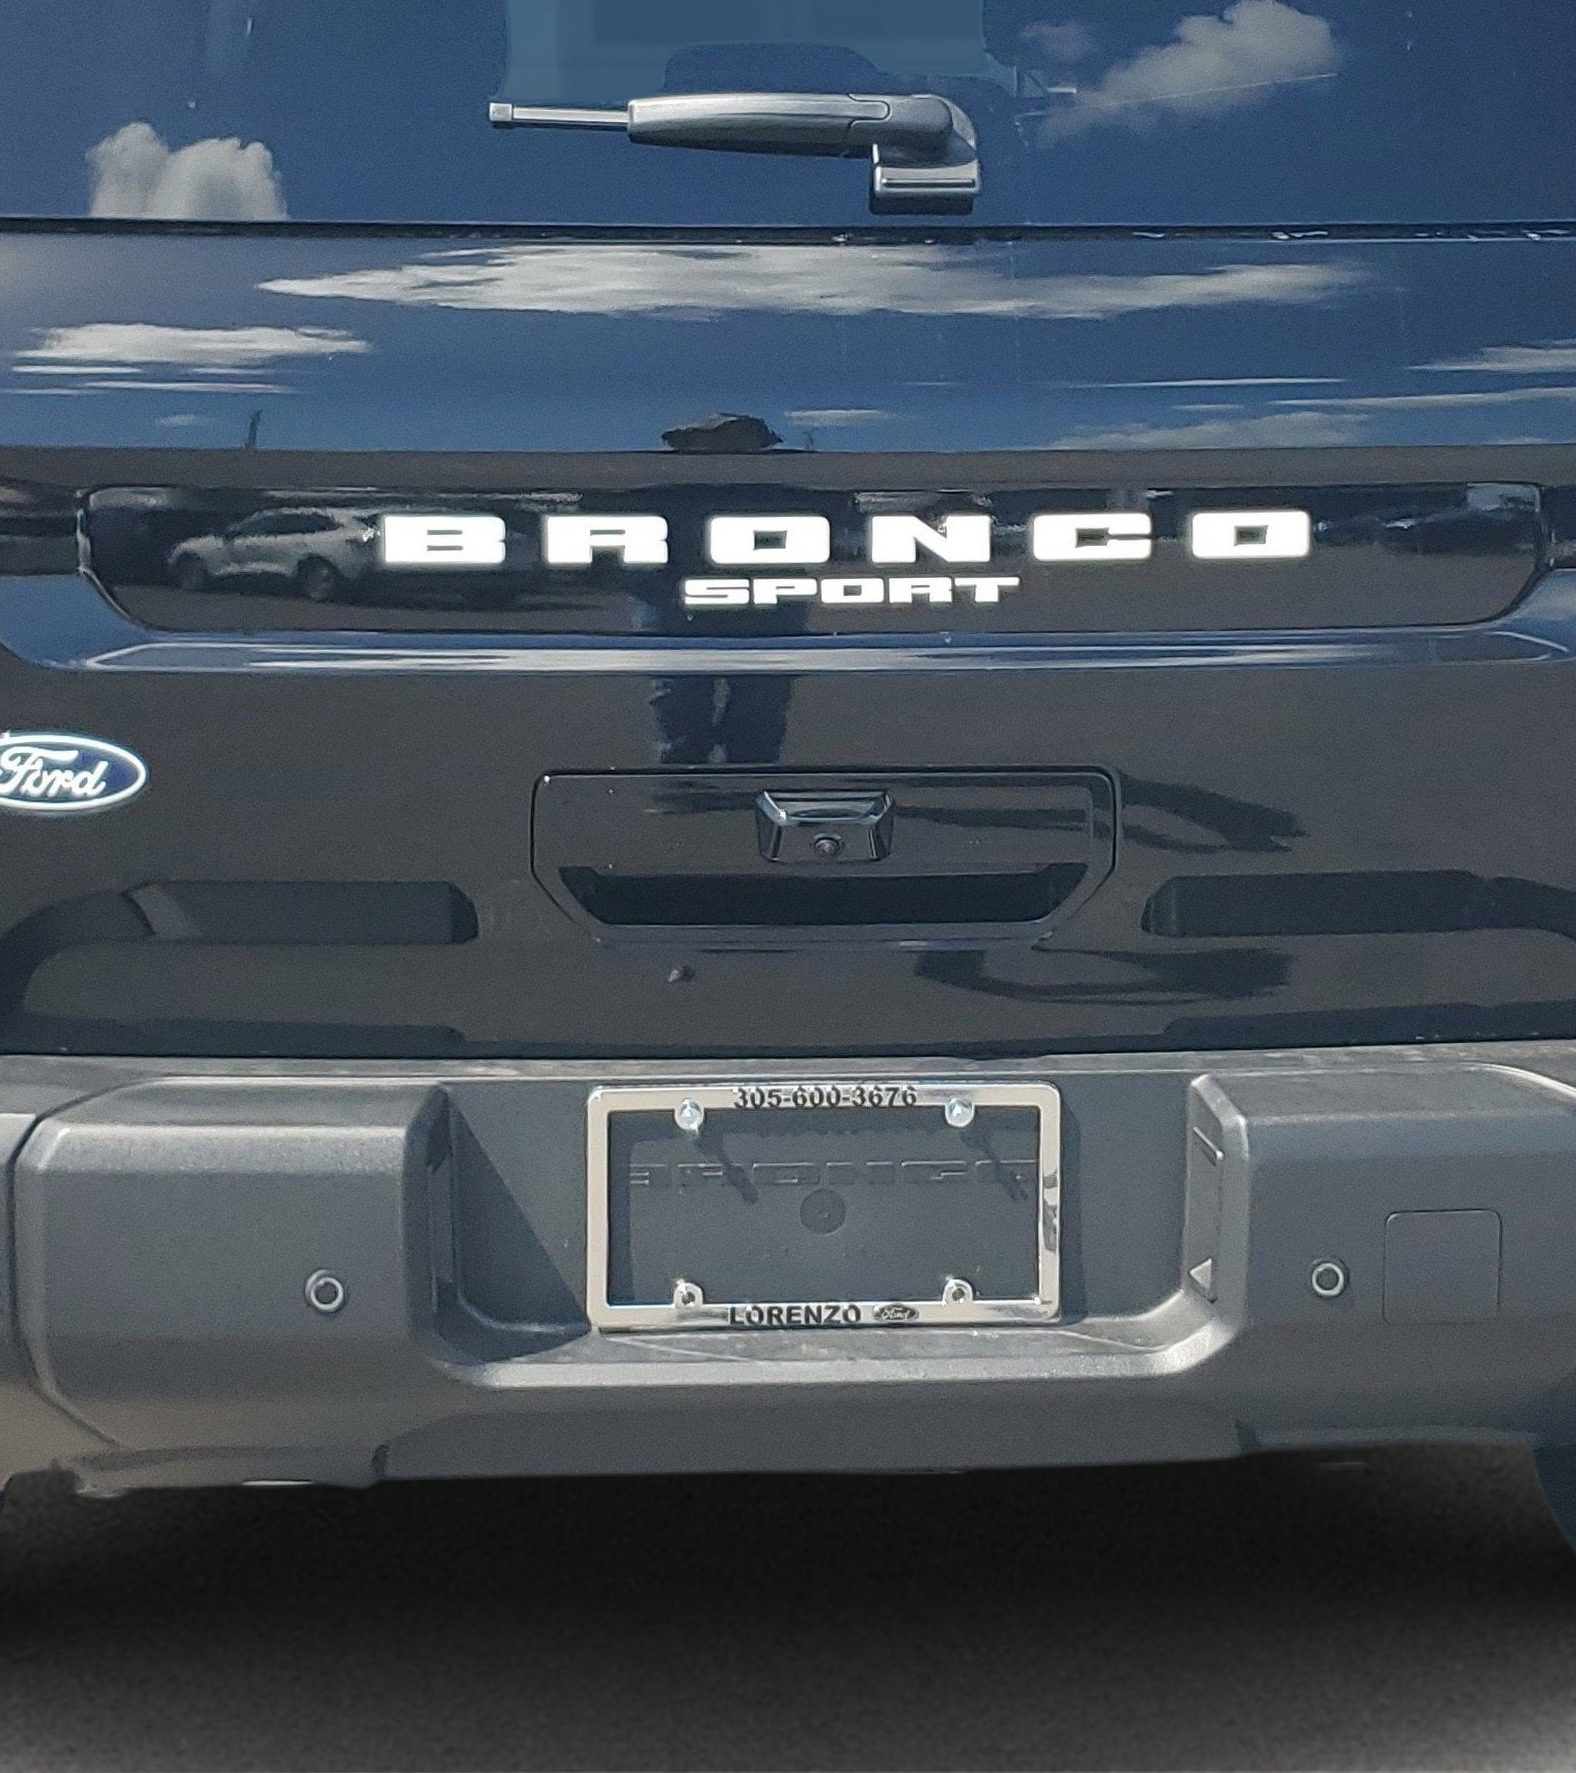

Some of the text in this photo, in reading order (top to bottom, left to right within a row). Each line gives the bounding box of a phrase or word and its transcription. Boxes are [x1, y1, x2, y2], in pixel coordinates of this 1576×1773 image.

[382, 510, 1311, 564] BRONCO
[683, 576, 1020, 605] SPORT
[733, 1085, 918, 1109] 305-600-3676
[729, 1305, 862, 1325] LORENZO
